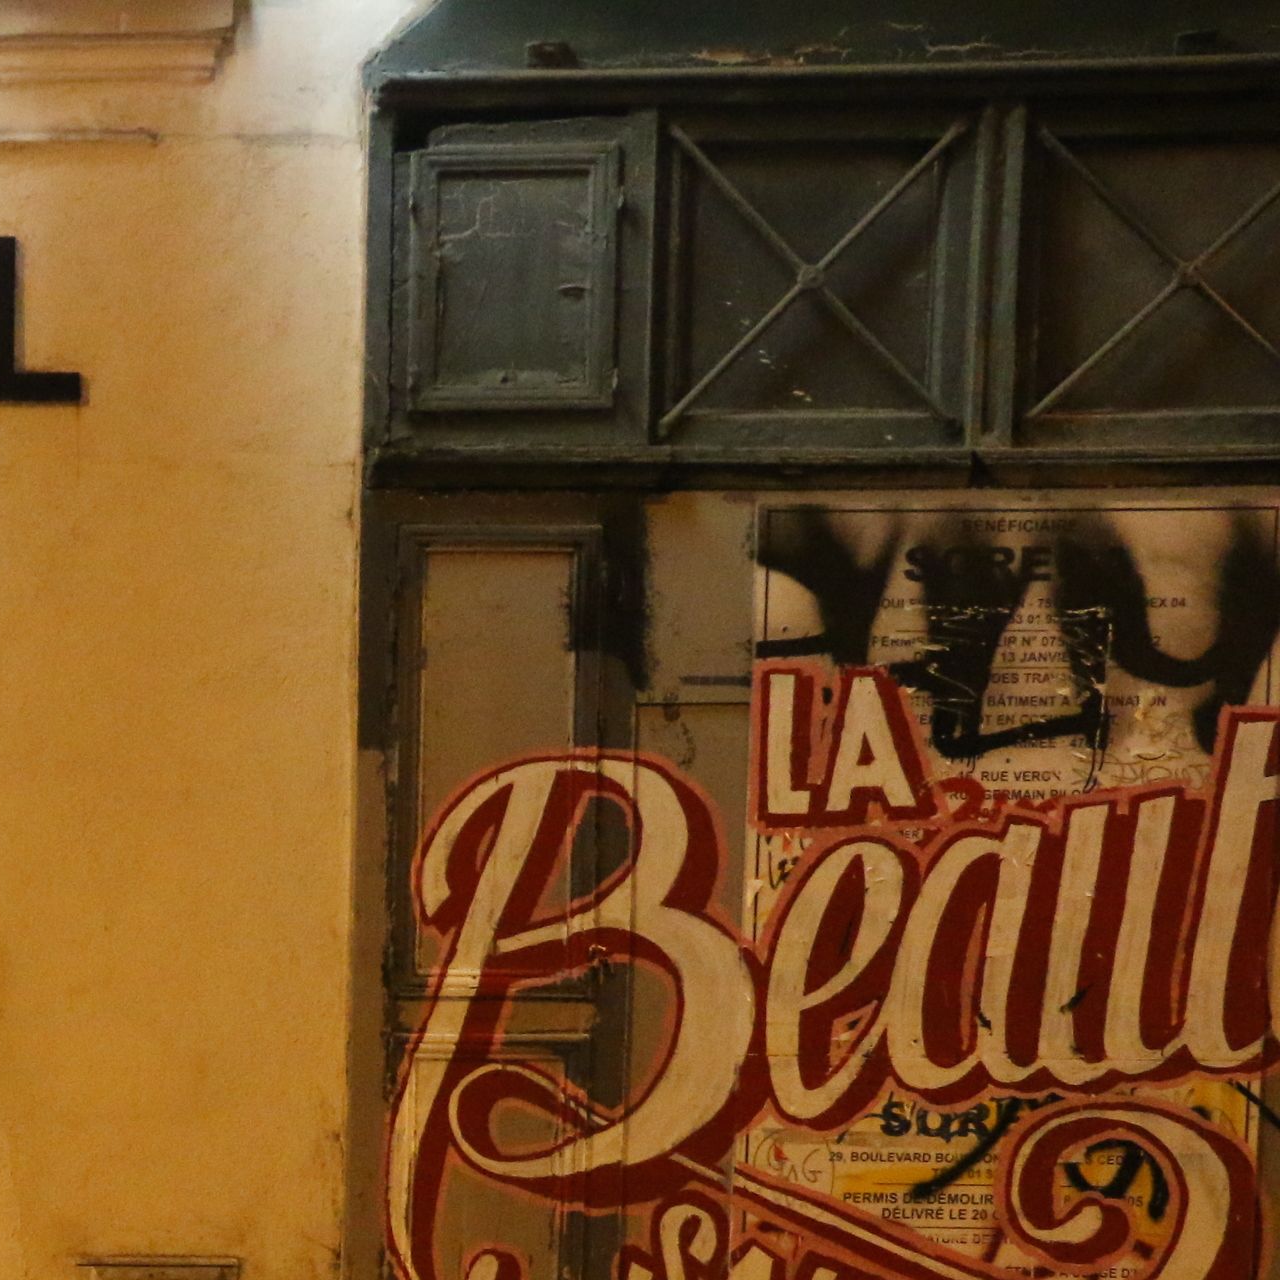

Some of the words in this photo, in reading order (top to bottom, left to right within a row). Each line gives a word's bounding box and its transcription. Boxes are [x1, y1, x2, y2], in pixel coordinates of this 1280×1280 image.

[758, 668, 934, 824] LA
[981, 771, 1008, 782] RUE
[850, 1151, 931, 1163] BOULEVARD
[843, 1192, 898, 1204] PERMIS
[881, 1206, 945, 1220] DÉLIVRÉ
[949, 1208, 966, 1219] LE
[971, 1208, 987, 1219] 20
